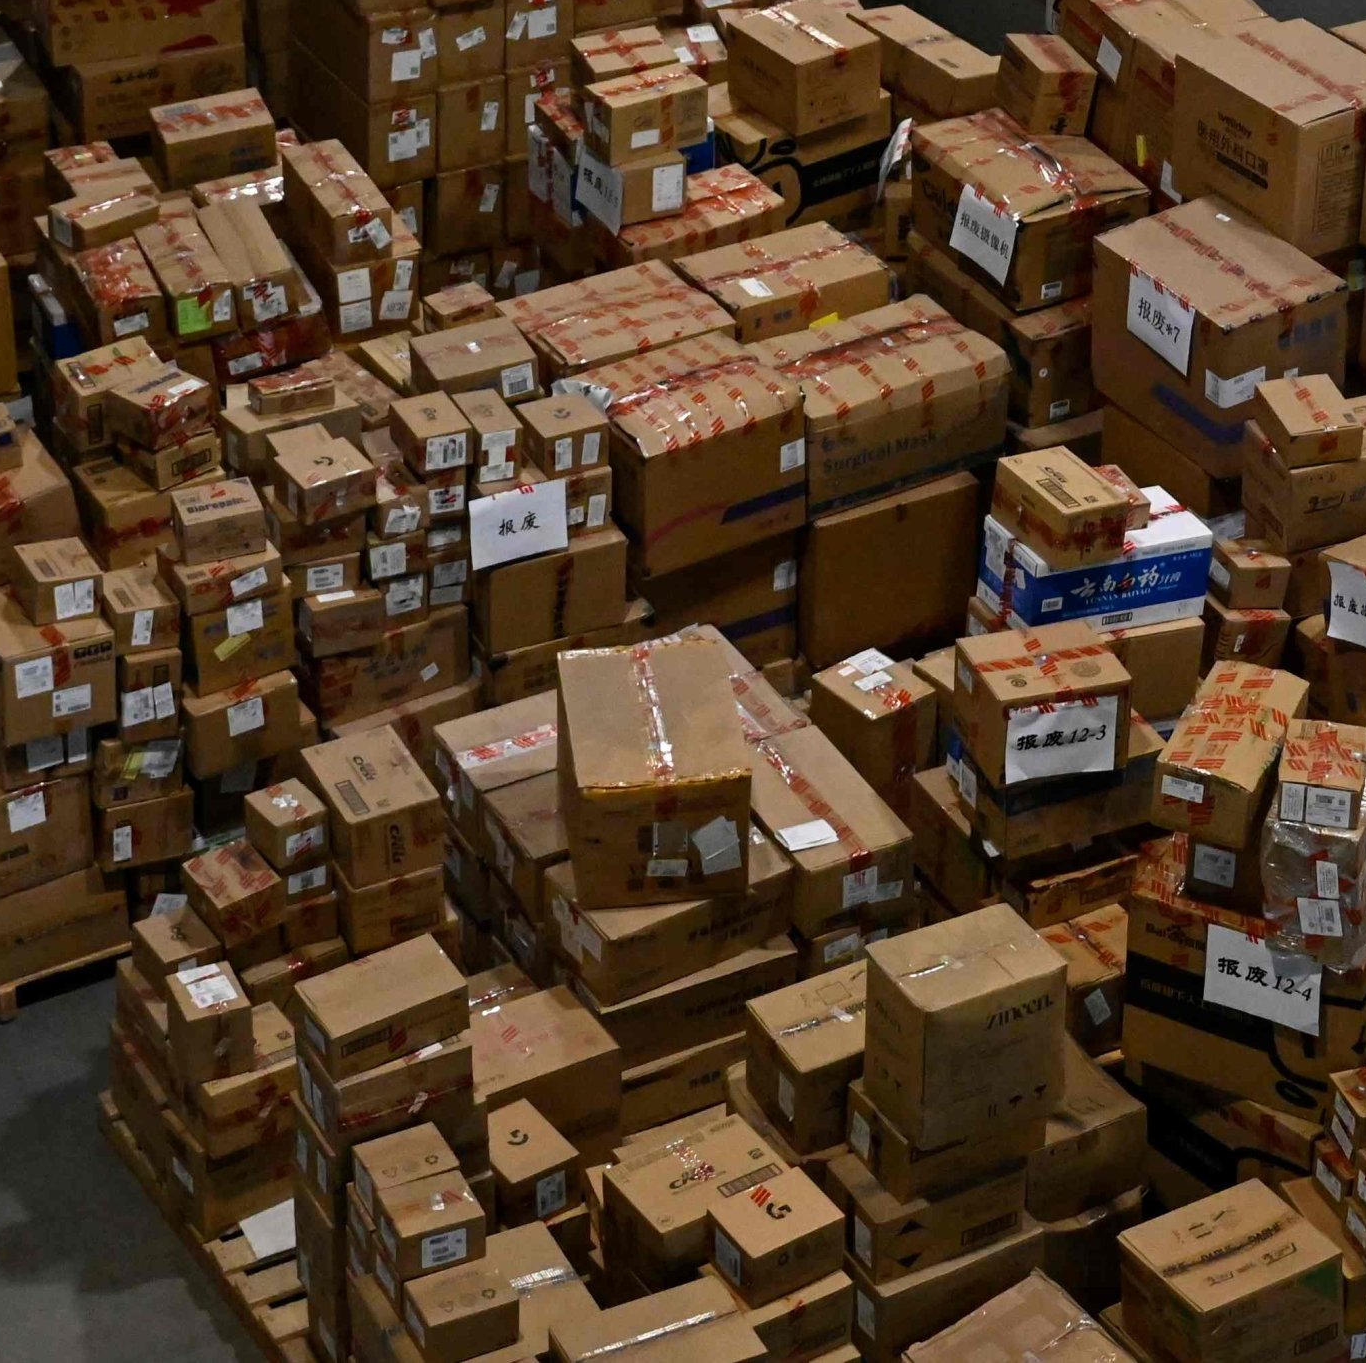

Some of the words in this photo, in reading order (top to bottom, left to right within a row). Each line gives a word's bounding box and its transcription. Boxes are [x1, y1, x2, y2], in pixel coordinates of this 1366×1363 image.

[498, 511, 540, 536] 报废
[1069, 564, 1159, 599] 云南白药
